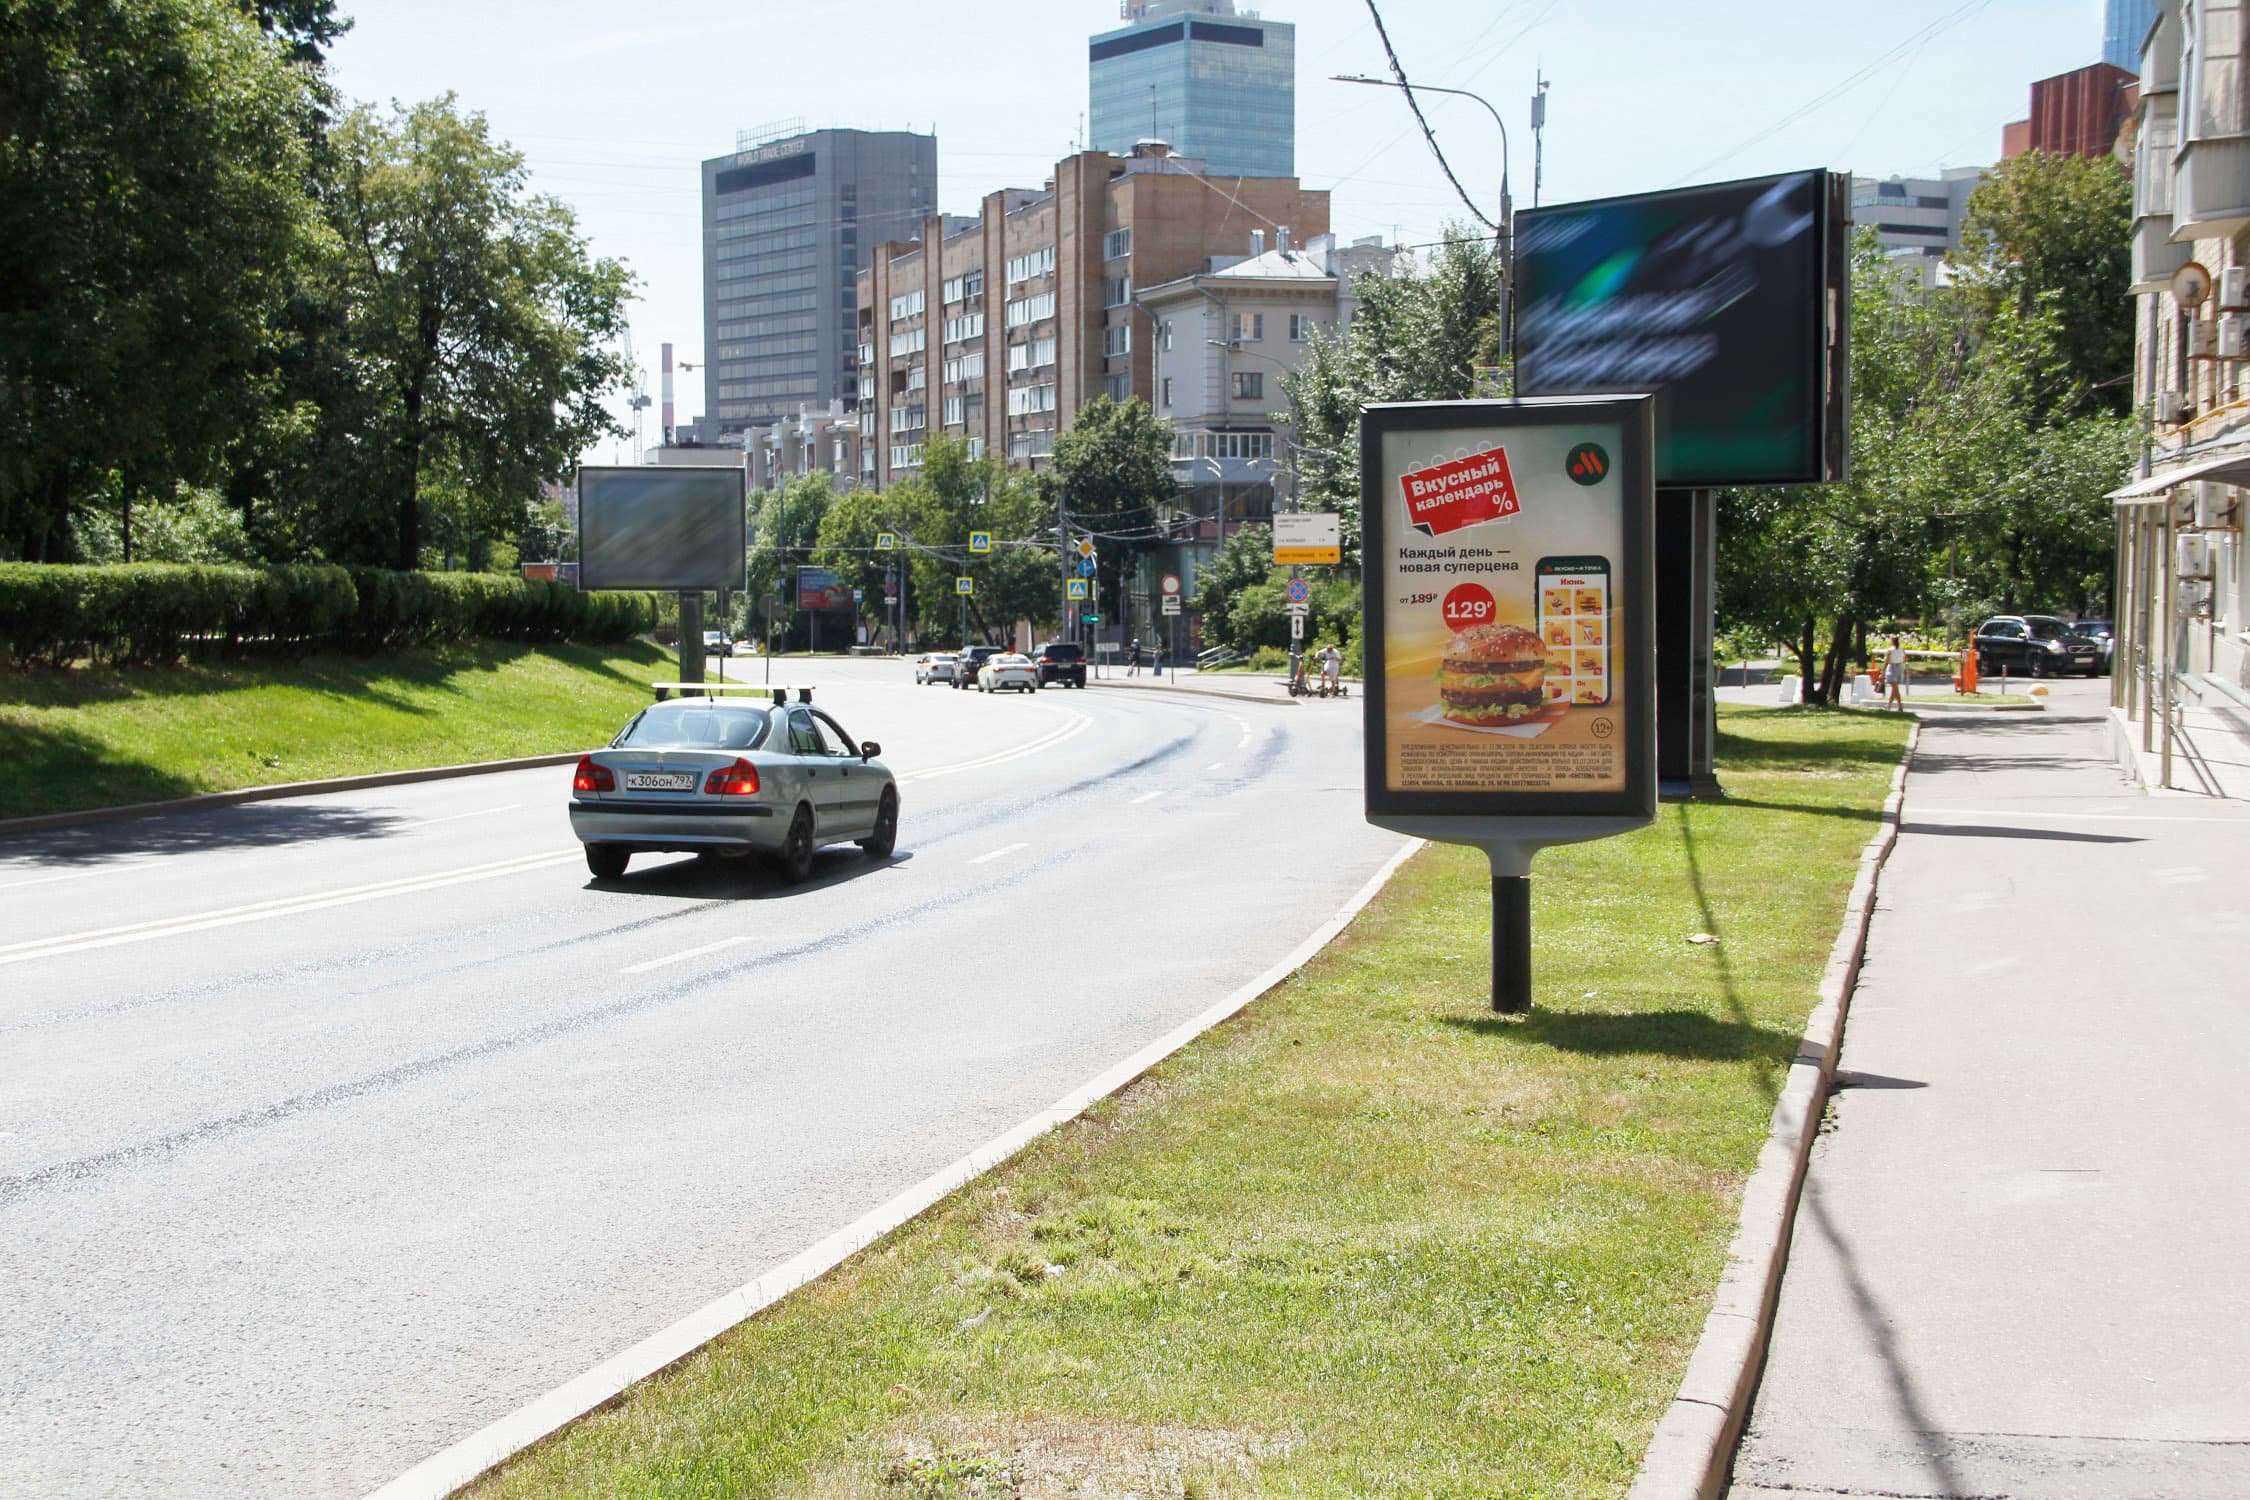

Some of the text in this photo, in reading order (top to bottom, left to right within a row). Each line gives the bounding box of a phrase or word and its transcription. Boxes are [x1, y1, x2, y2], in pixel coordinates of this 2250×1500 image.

[1411, 457, 1501, 496] Вкусный
[1416, 480, 1504, 511] календарь
[1492, 491, 1513, 513] %
[1400, 547, 1456, 560] Каждый
[1459, 548, 1493, 559] день
[1400, 561, 1519, 574] новая суперцена
